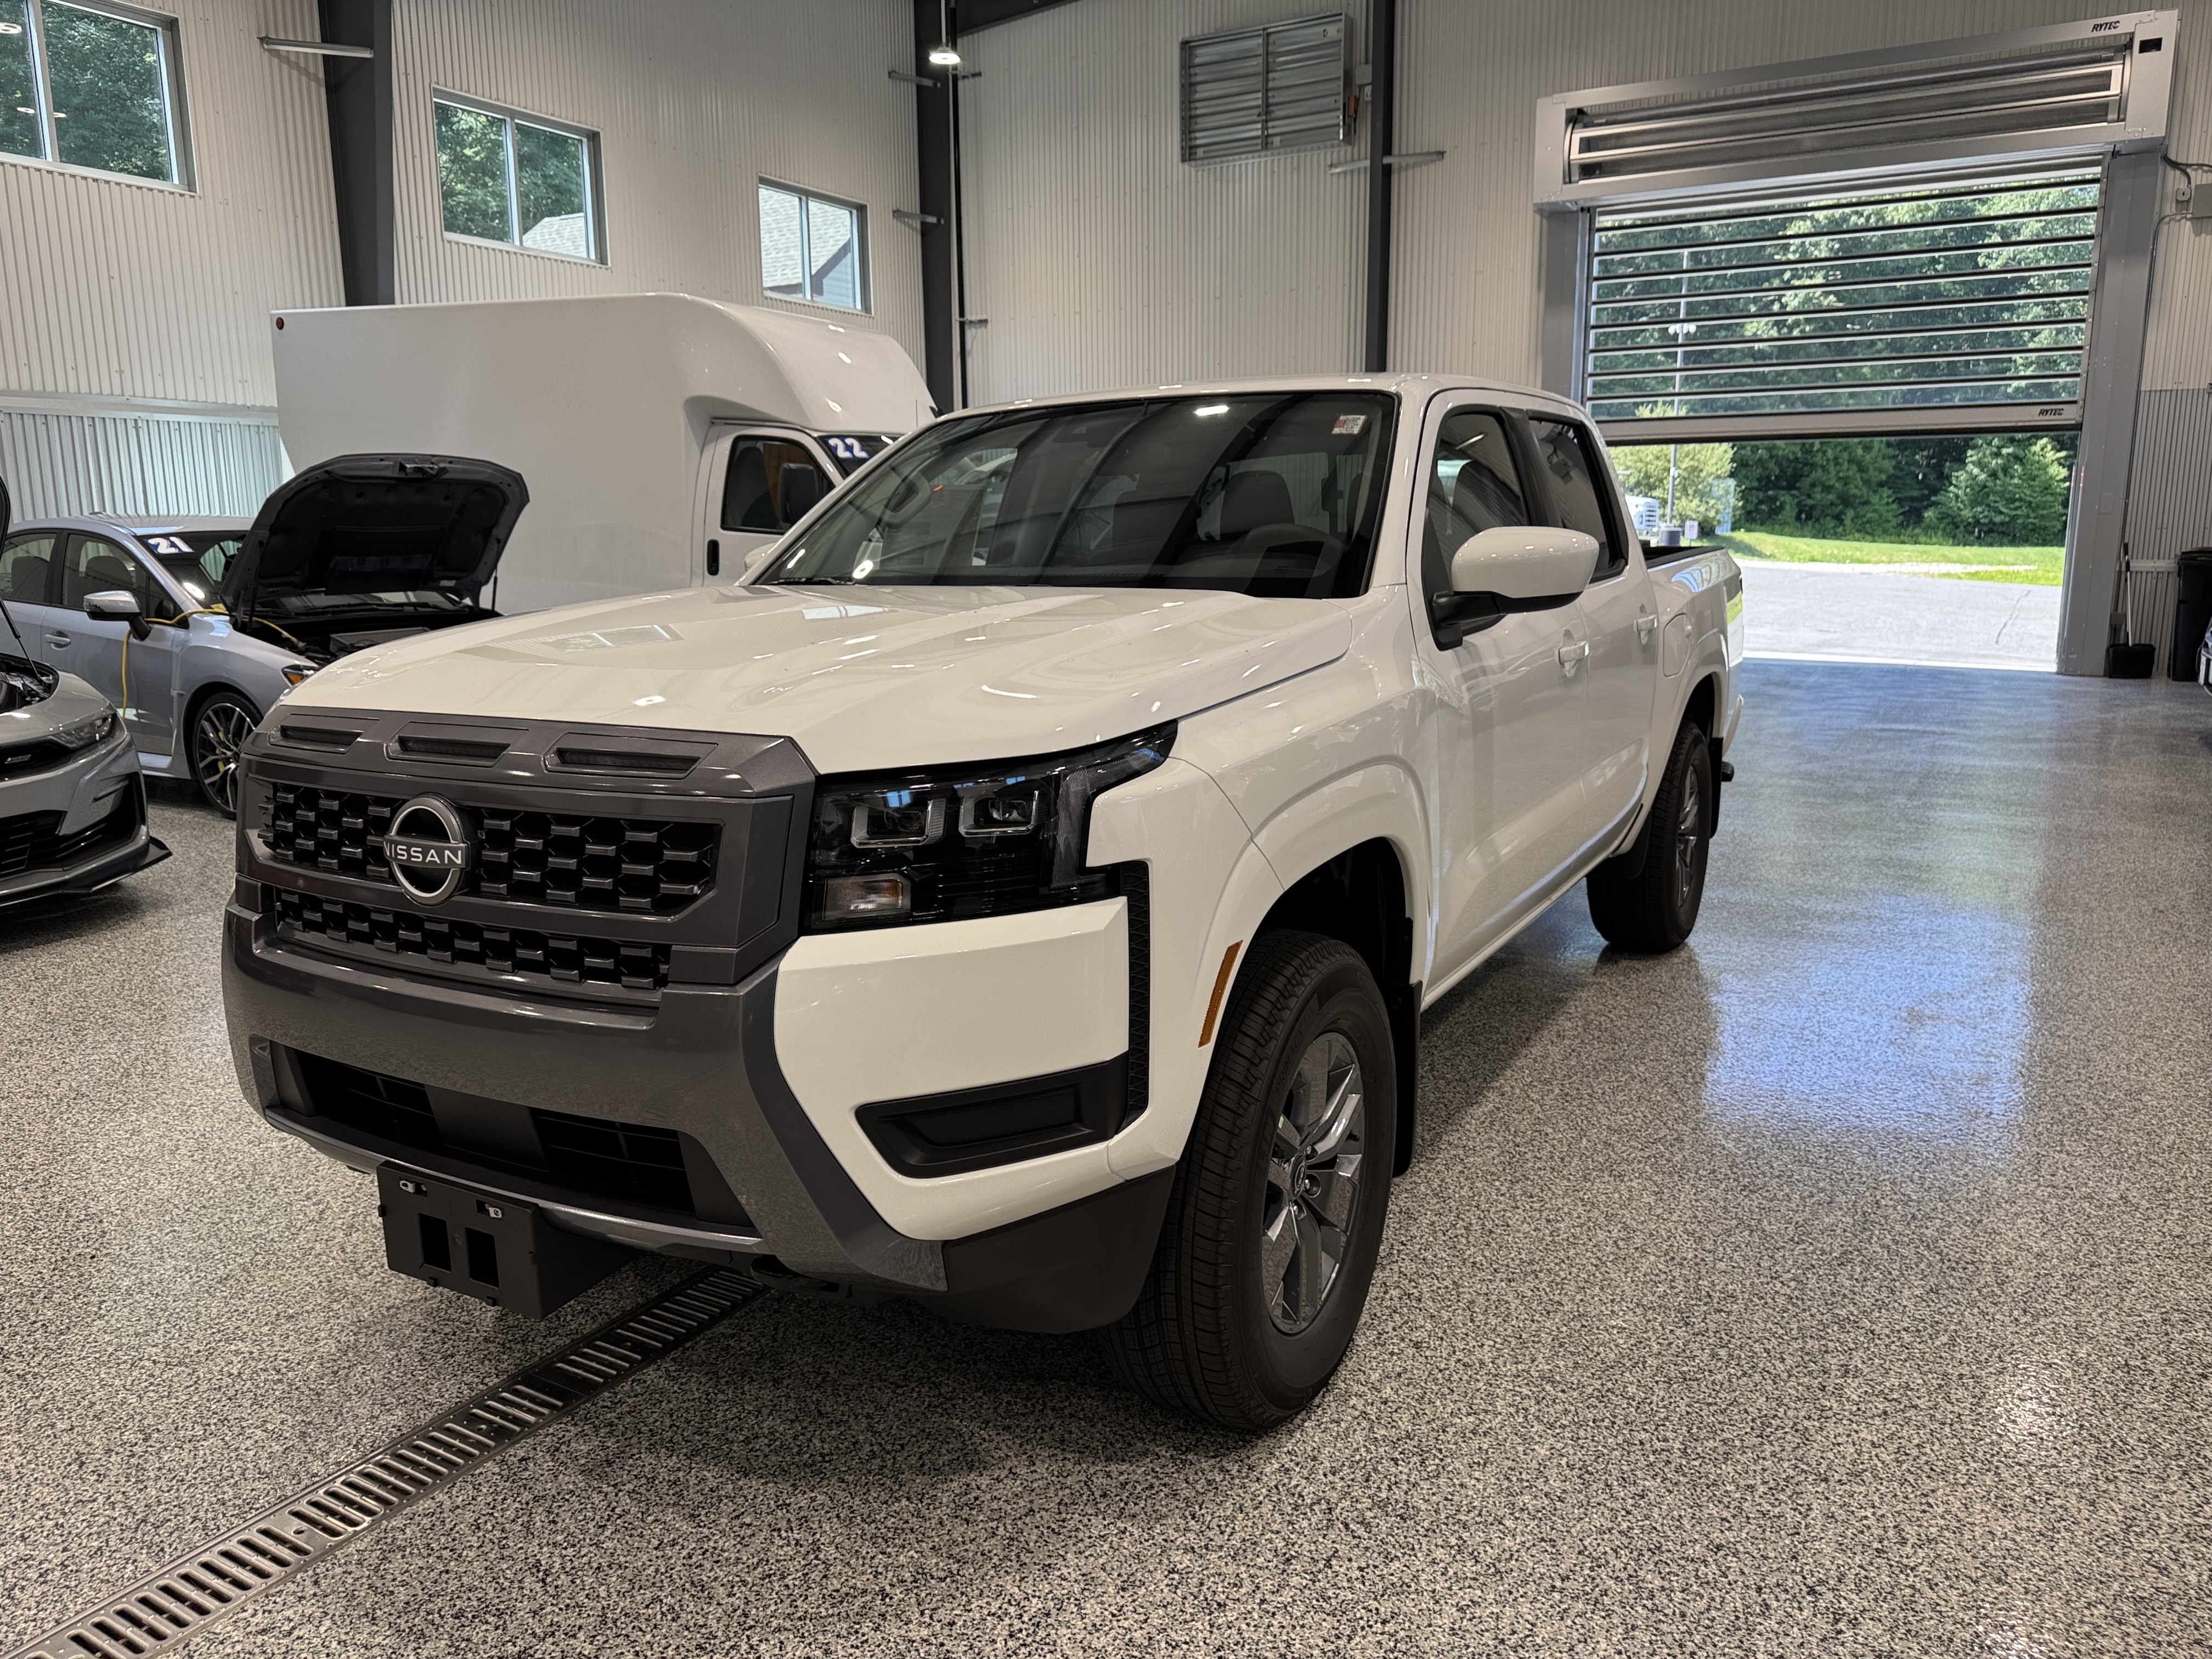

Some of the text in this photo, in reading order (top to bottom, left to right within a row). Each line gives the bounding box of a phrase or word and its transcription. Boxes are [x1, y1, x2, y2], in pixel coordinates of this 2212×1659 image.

[2091, 20, 2120, 32] RYTEC
[2038, 408, 2064, 417] RYTEC
[828, 437, 868, 458] 22
[148, 537, 194, 554] 21
[383, 840, 462, 864] NISSAN
